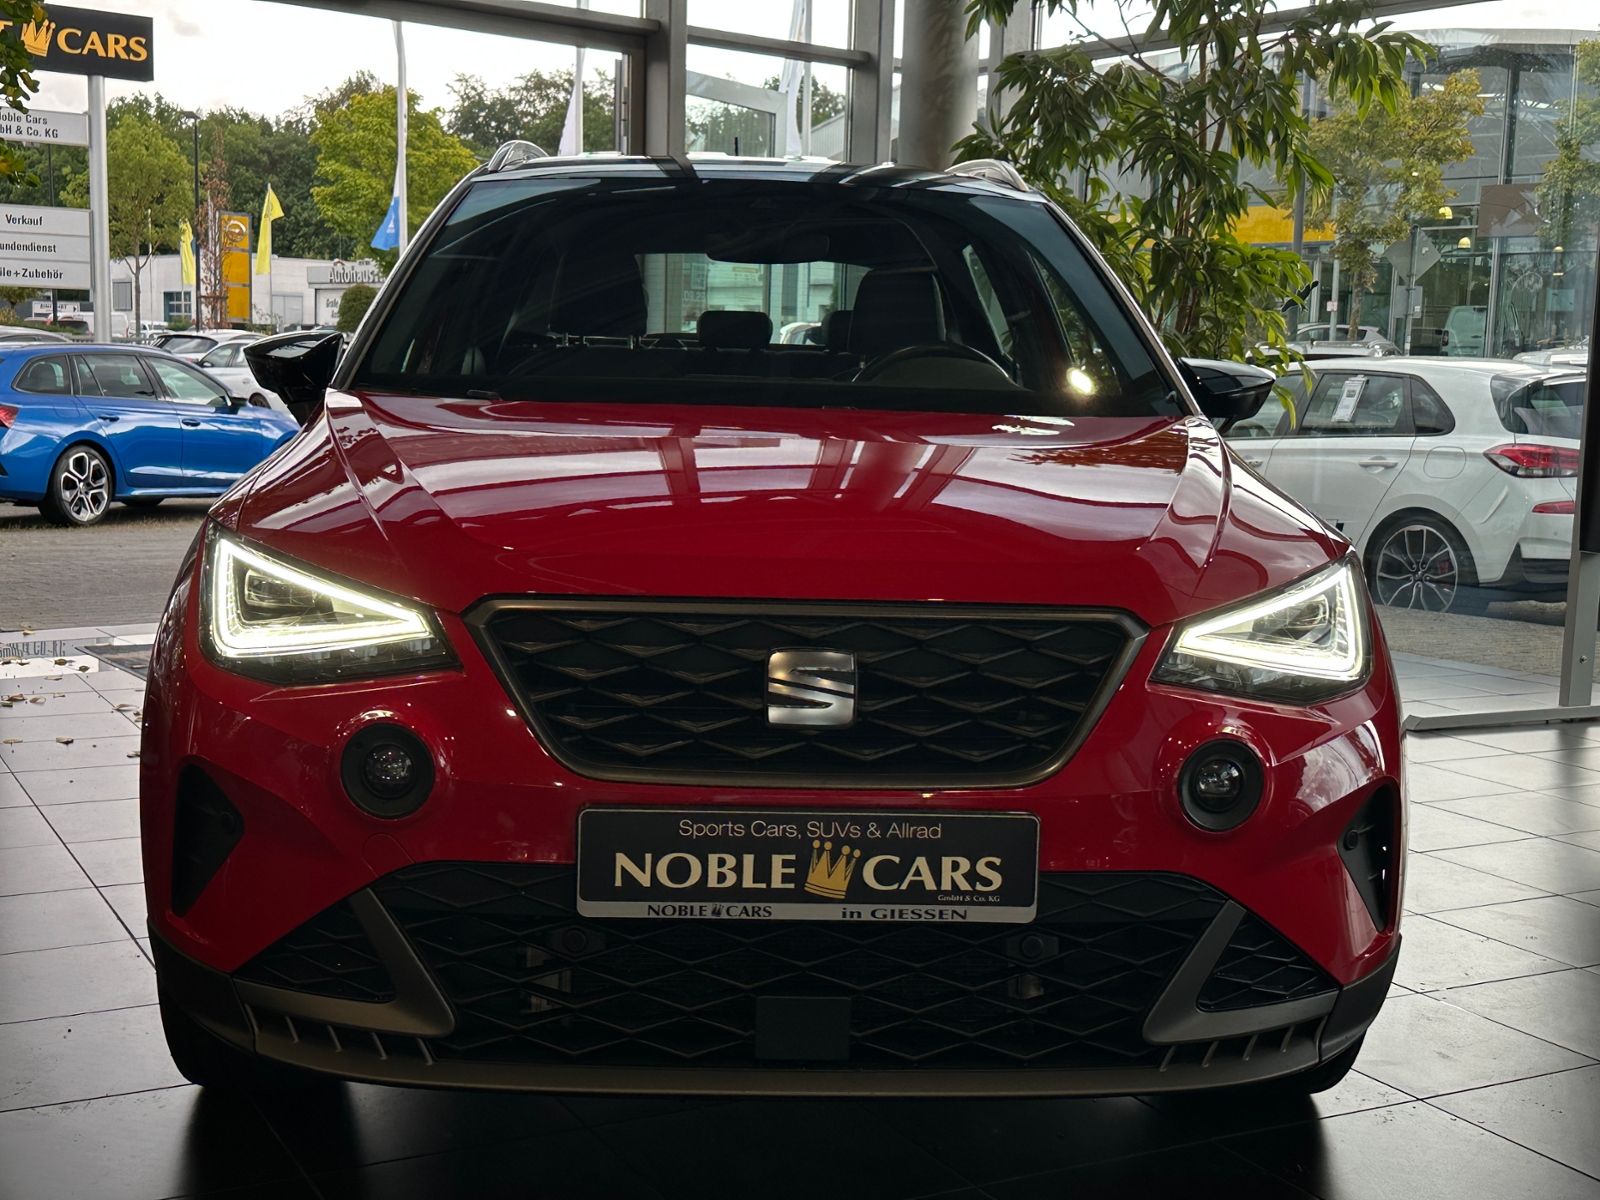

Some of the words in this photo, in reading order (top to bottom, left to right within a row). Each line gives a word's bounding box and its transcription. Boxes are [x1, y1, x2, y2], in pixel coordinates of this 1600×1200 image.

[56, 27, 148, 61] CARS
[0, 112, 22, 123] oble
[25, 114, 48, 126] Cars
[15, 125, 23, 136] &
[26, 126, 42, 137] Co.
[44, 128, 59, 139] KG
[5, 213, 43, 226] Verkauf
[329, 265, 375, 284] Autohaus
[678, 819, 746, 840] Sports
[750, 820, 802, 840] Cars,
[806, 821, 861, 838] SUVs
[866, 822, 881, 838] &
[886, 822, 942, 839] Allrad
[614, 852, 797, 889] NOBLE
[862, 854, 1004, 892] CARS
[647, 904, 708, 917] NOBLE
[726, 905, 773, 918] CARS
[841, 907, 863, 919] in
[870, 908, 968, 920] GIESSEN
